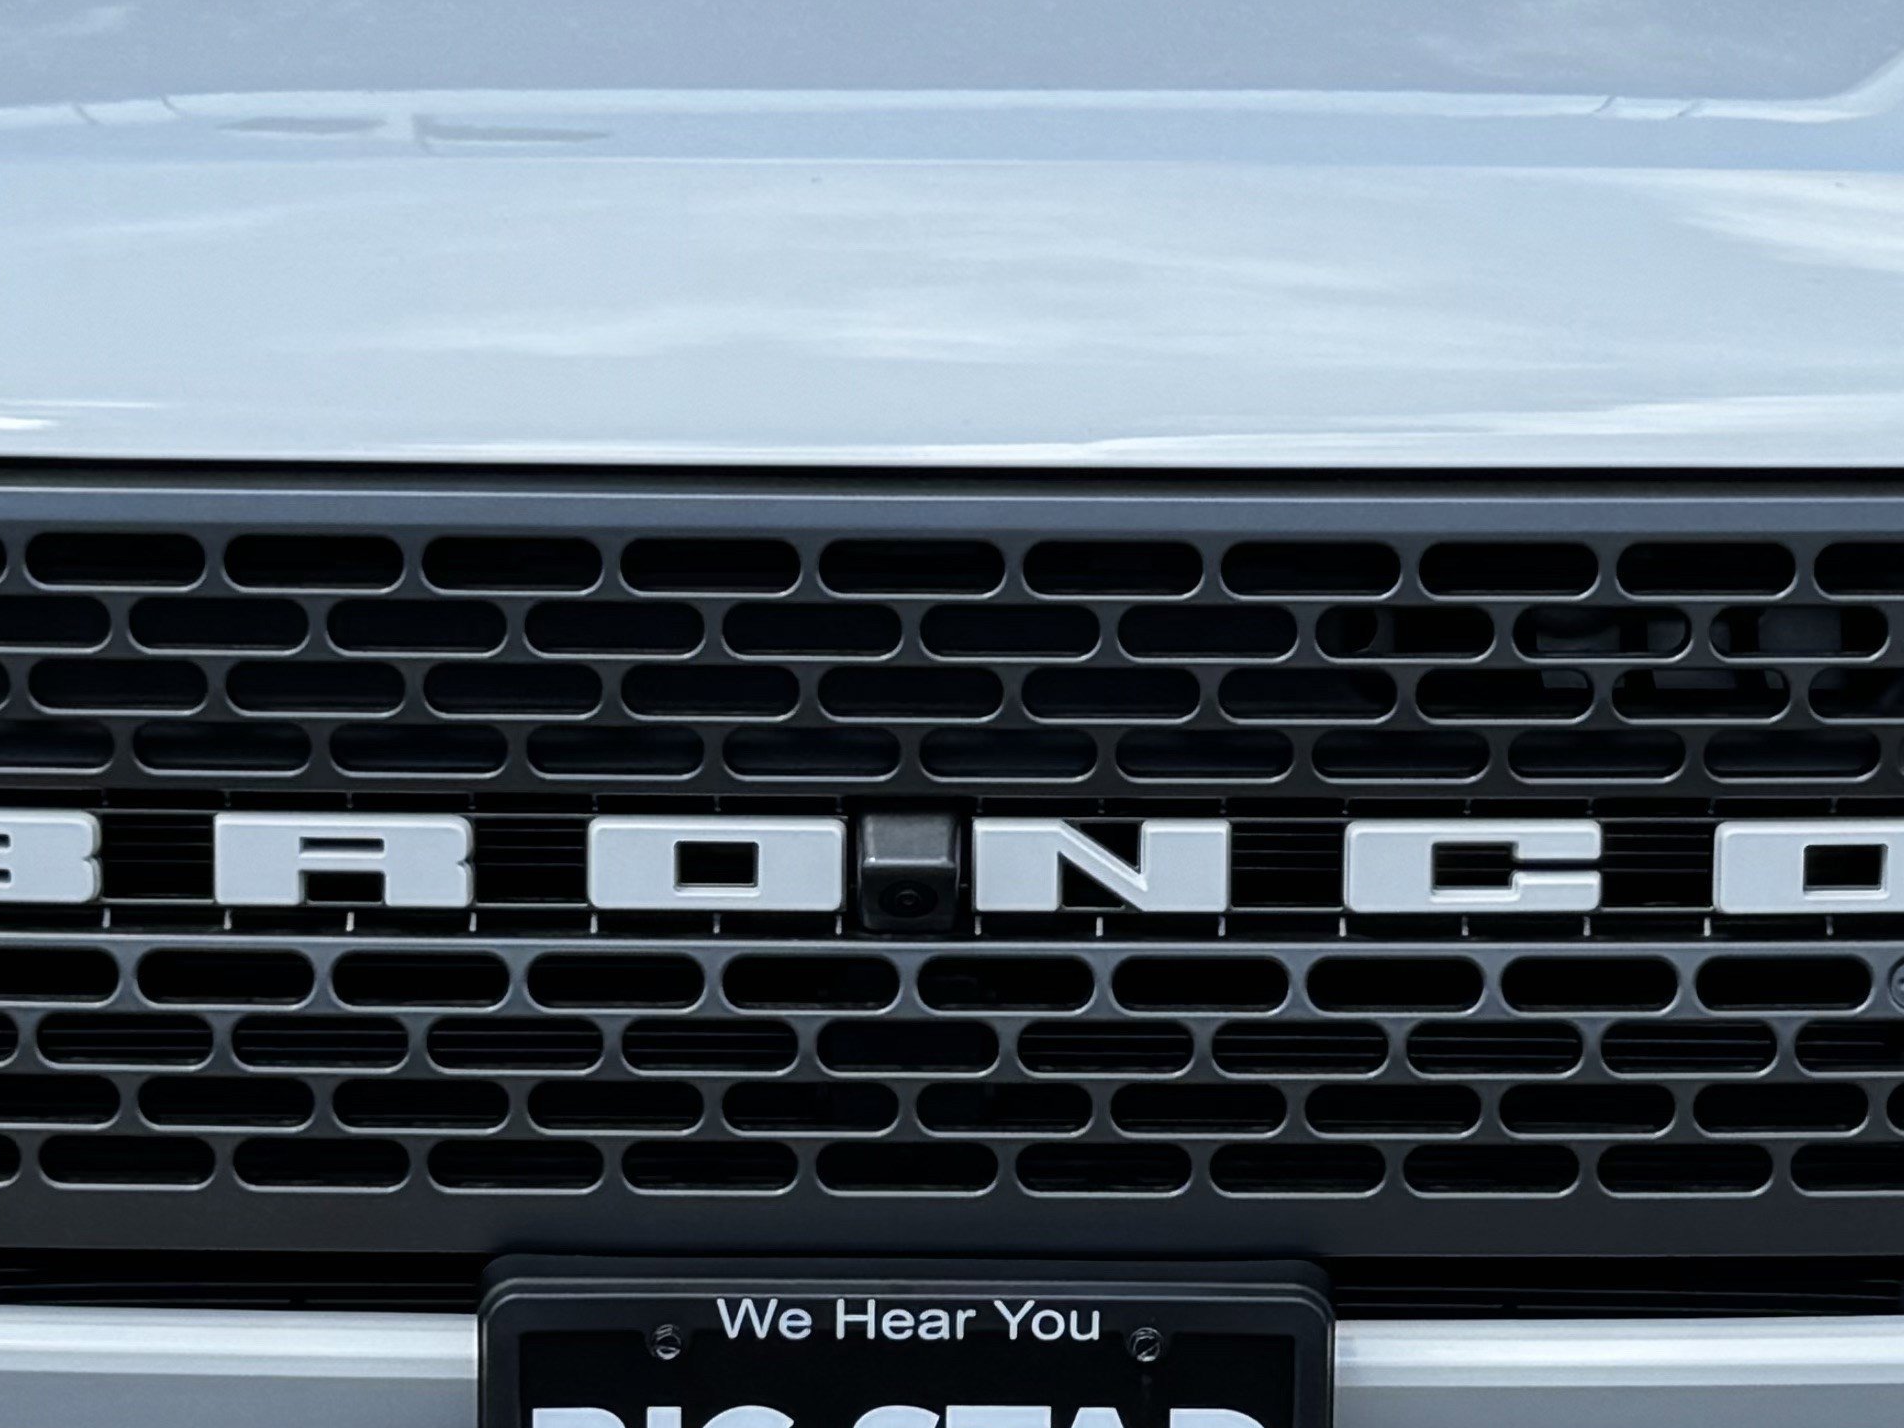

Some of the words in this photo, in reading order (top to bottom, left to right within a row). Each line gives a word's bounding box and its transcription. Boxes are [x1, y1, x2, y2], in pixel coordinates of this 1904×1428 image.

[716, 1297, 813, 1341] We
[835, 1298, 977, 1341] Hear
[993, 1299, 1101, 1342] You
